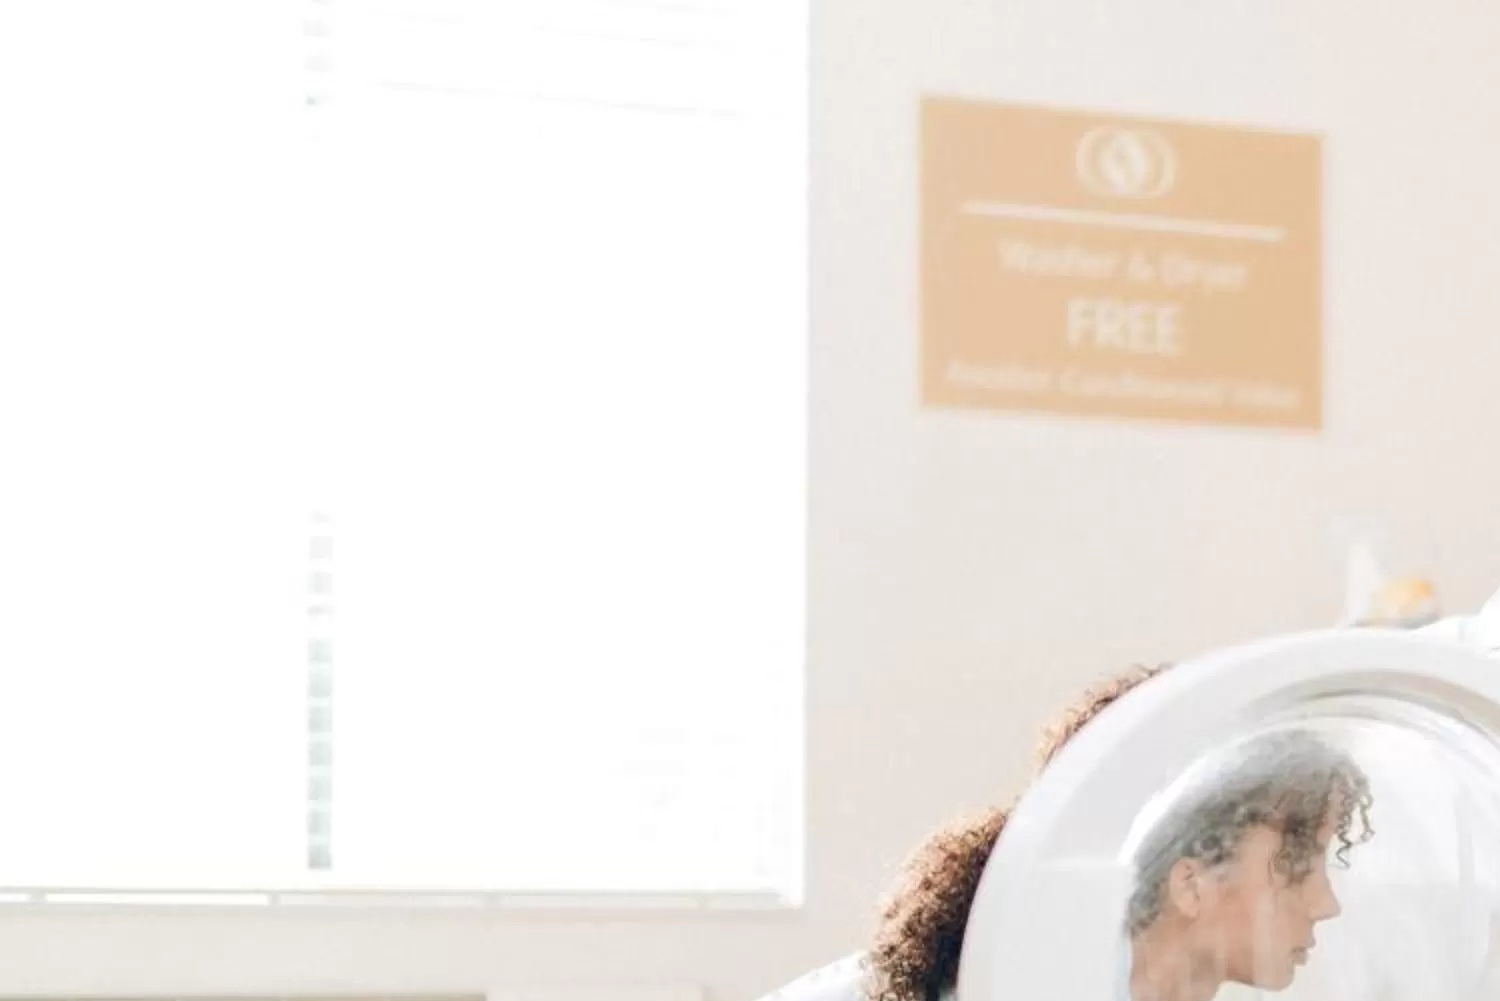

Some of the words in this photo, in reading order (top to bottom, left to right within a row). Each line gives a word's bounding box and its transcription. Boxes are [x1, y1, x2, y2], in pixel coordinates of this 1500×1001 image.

[997, 240, 1117, 278] Washer
[1127, 252, 1156, 281] &
[1066, 299, 1184, 356] FREE
